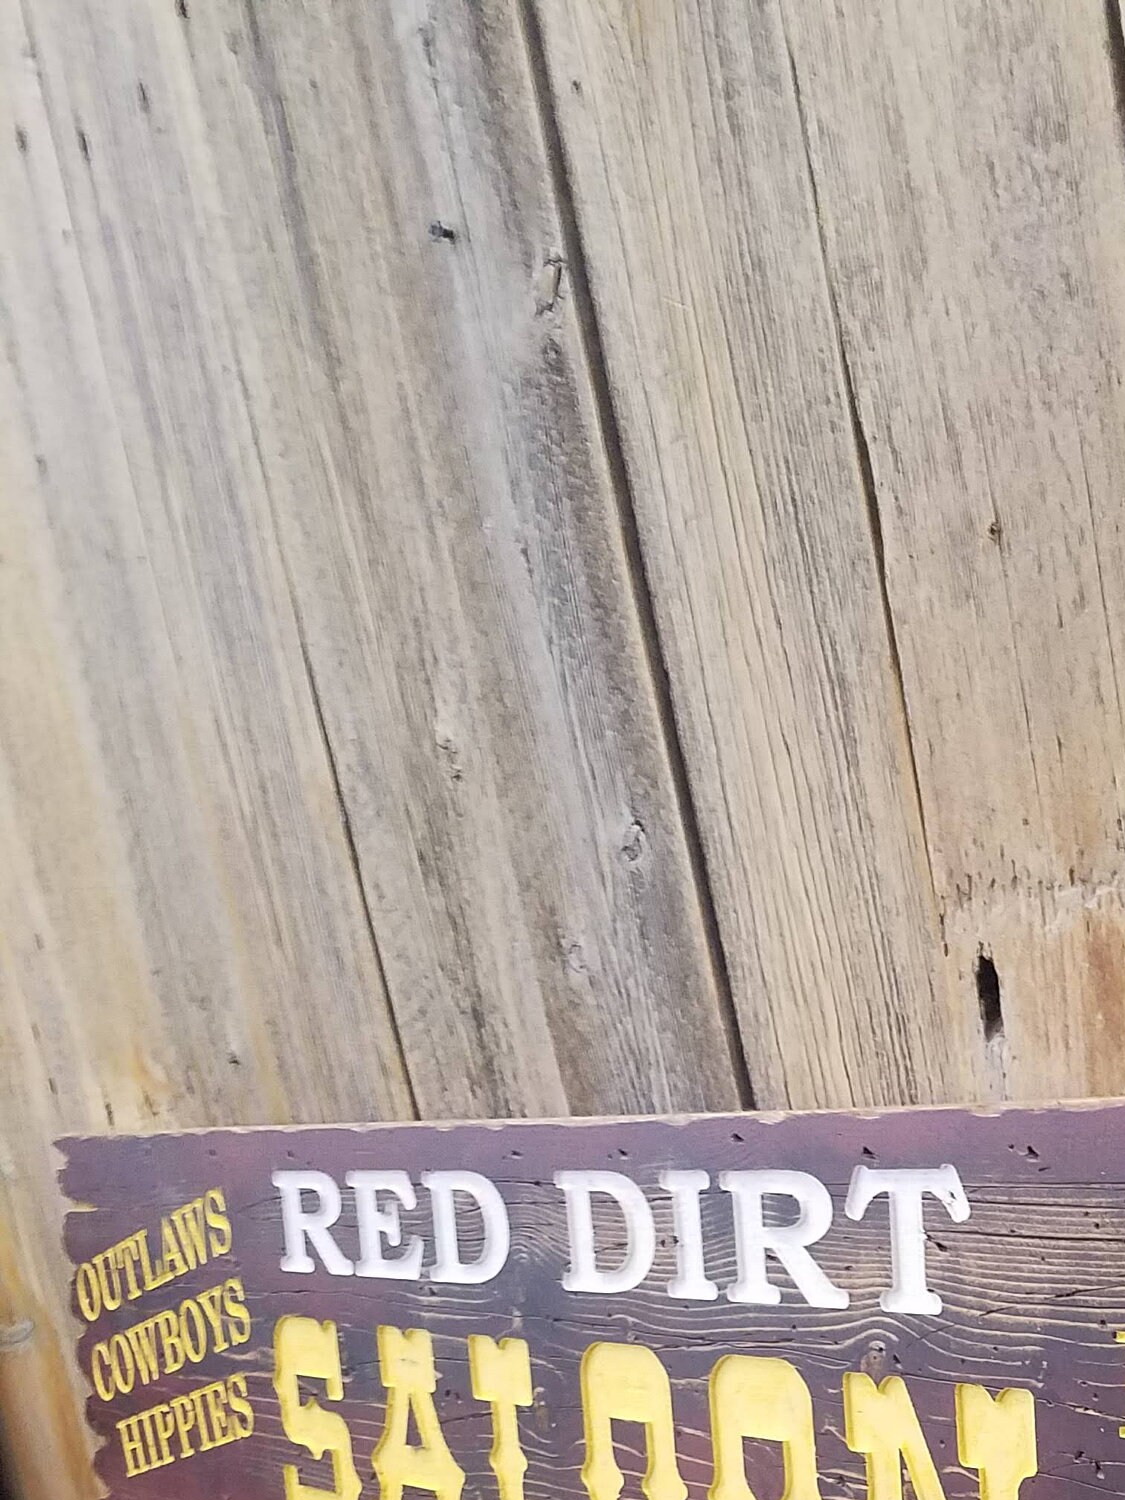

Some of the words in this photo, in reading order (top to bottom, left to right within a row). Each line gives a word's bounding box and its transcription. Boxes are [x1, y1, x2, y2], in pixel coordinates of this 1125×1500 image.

[75, 1188, 233, 1322] OUTLAWS
[271, 1169, 511, 1284] RED
[554, 1163, 971, 1316] DIRT
[91, 1277, 252, 1402] COWBOYS
[115, 1373, 256, 1478] HIPPIES
